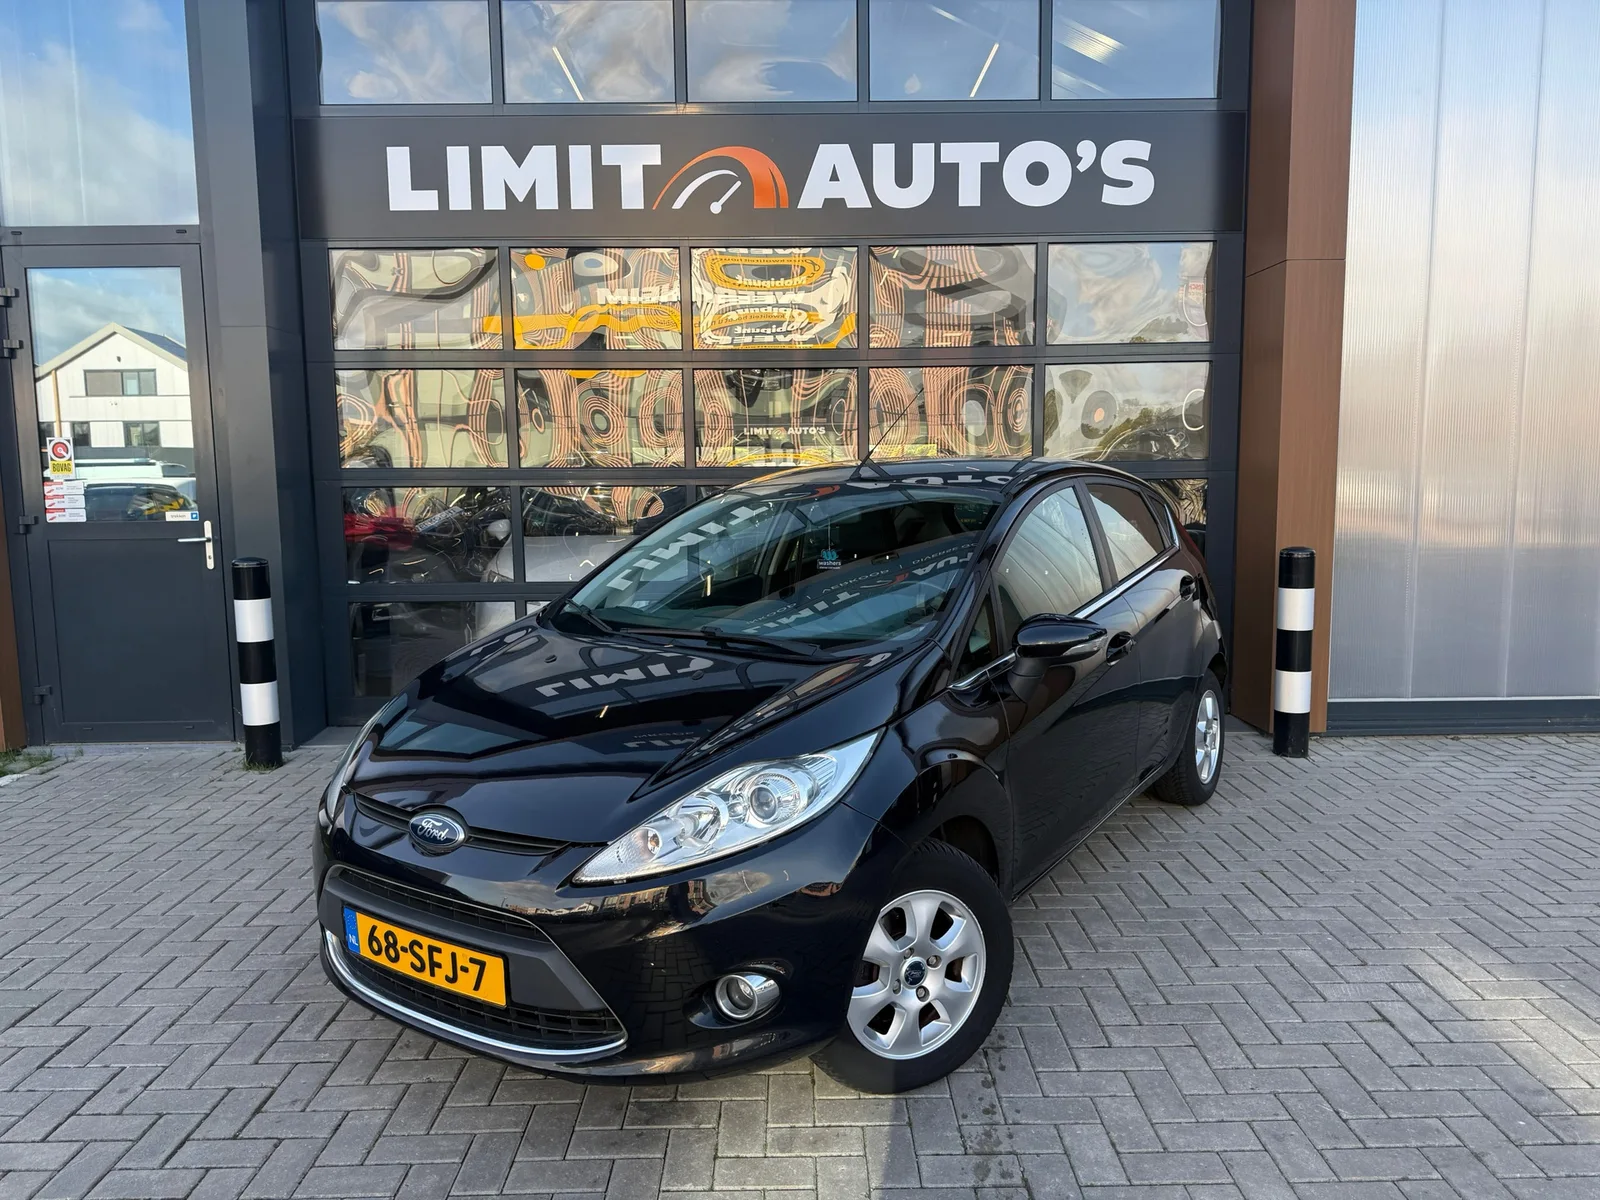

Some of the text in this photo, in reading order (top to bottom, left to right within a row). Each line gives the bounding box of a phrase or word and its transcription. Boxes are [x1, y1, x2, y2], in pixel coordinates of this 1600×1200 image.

[386, 139, 1156, 212] LIMIT AUTO'S
[743, 427, 826, 436] LIMIT AUTO'S
[52, 462, 72, 473] BOVAG
[416, 818, 449, 841] Ford
[348, 924, 487, 992] NL 68-SFJ-7
